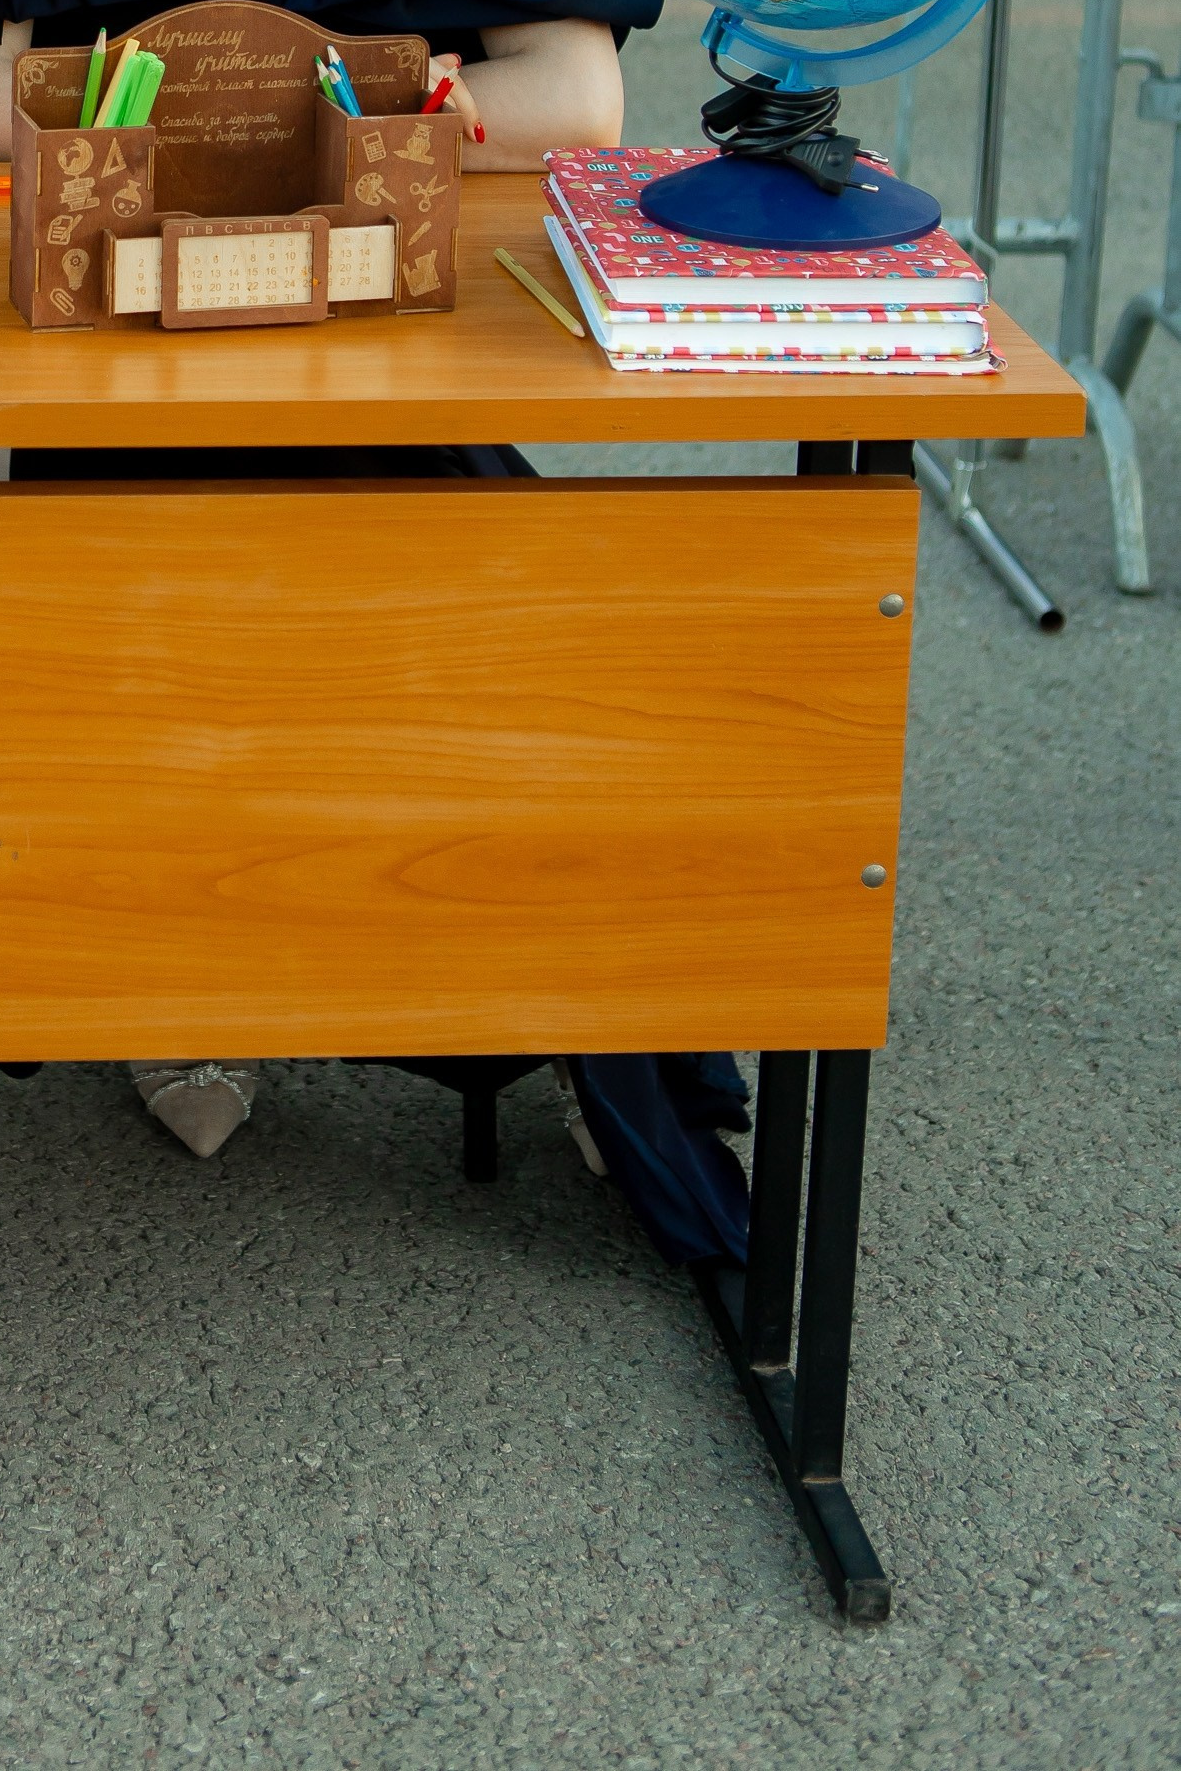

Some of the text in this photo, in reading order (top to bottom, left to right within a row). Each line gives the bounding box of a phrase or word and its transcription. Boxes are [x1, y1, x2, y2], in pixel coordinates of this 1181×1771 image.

[147, 25, 246, 59] Лучшему
[190, 46, 296, 83] учителю!
[160, 111, 205, 128] Спасибо
[205, 117, 222, 131] за
[155, 134, 199, 150] ерпение
[587, 162, 619, 173] ONE
[269, 239, 275, 248] 2
[630, 233, 665, 244] ONE
[139, 259, 145, 268] 2
[250, 253, 257, 263] 8
[269, 252, 276, 262] 9
[285, 251, 296, 261] 10
[248, 267, 259, 277] 15
[266, 266, 277, 276] 16
[285, 265, 295, 275] 17
[210, 283, 222, 293] 20
[229, 282, 240, 291] 21
[247, 281, 259, 291] 22
